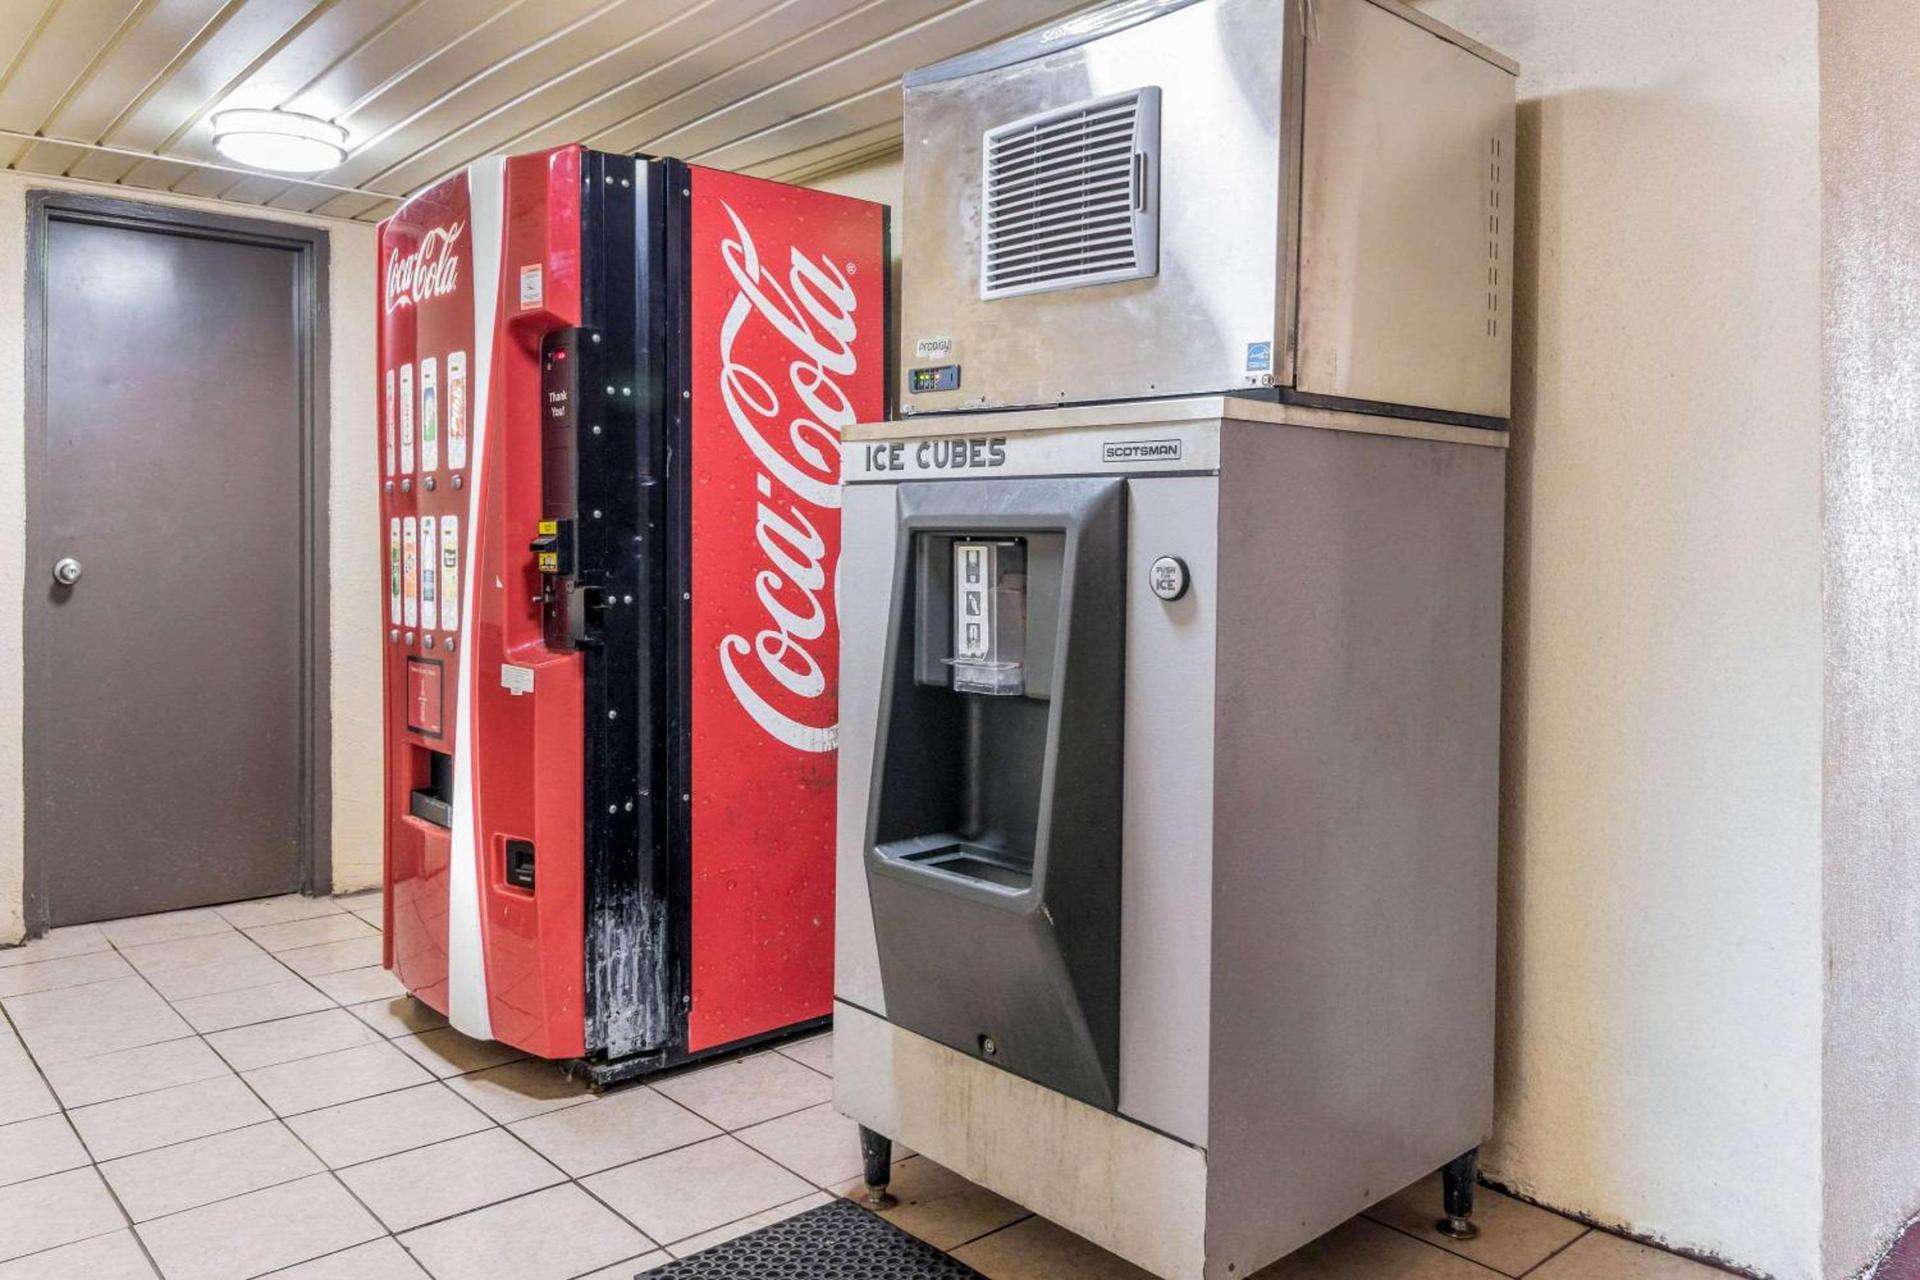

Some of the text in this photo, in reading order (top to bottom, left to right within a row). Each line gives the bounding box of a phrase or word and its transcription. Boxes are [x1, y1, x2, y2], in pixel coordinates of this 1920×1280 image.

[385, 219, 466, 315] Coca-Cola
[548, 389, 568, 403] Thank
[551, 405, 566, 418] You!
[865, 437, 1007, 472] ICE CUBES
[1106, 444, 1178, 458] SCOTSMAN
[719, 199, 858, 753] Coca-Cola
[1155, 578, 1176, 591] ICE
